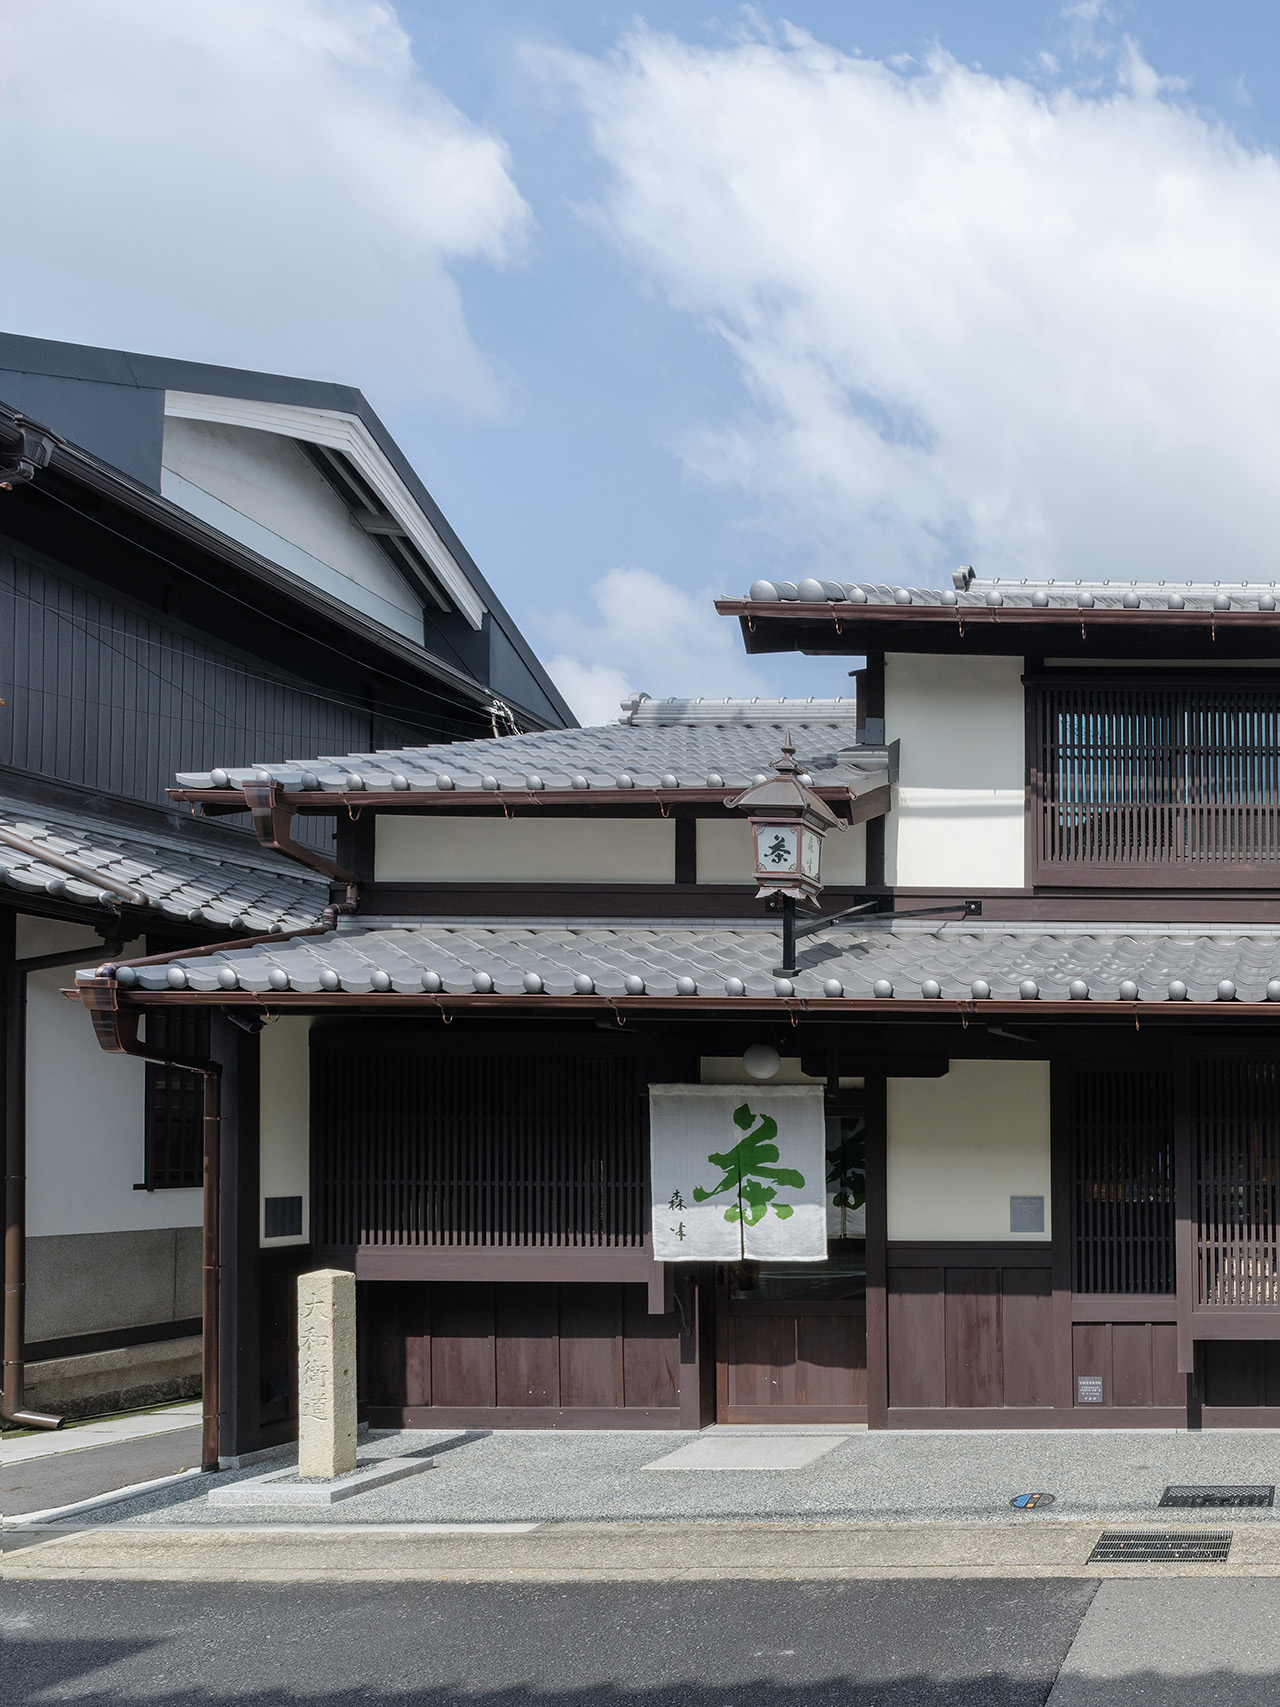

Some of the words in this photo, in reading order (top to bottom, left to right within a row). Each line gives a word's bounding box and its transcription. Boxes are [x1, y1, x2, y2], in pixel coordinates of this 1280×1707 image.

[764, 834, 791, 863] 茶
[692, 1103, 806, 1227] 茶
[300, 1292, 329, 1421] 大和街道
